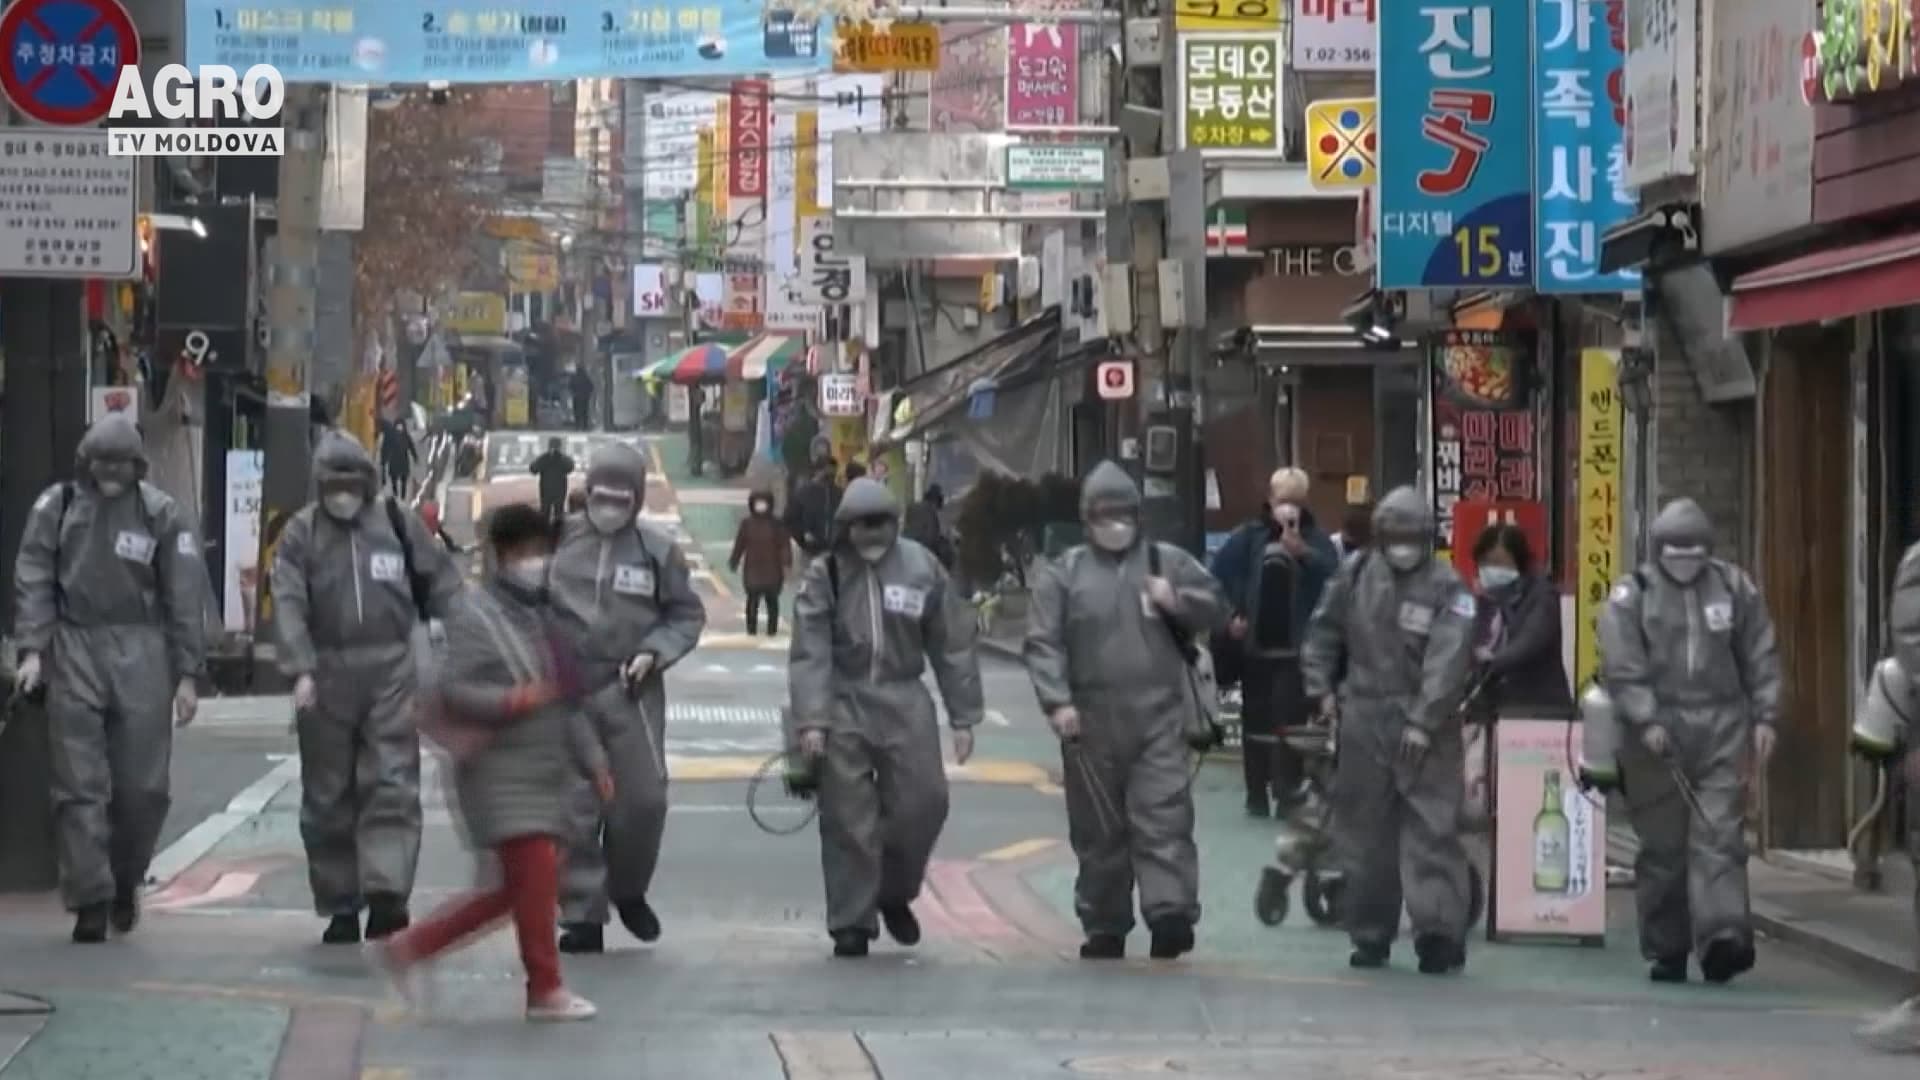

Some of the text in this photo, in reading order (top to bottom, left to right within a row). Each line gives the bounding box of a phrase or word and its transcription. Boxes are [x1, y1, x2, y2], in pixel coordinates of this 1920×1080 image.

[16, 44, 118, 66] 주정차금지
[1188, 45, 1273, 78] 로데오
[1188, 85, 1273, 119] 부동산
[1192, 126, 1243, 145] 주차장
[1383, 211, 1452, 236] 디지털
[1269, 247, 1322, 275] THE
[1454, 226, 1526, 278] 15 분
